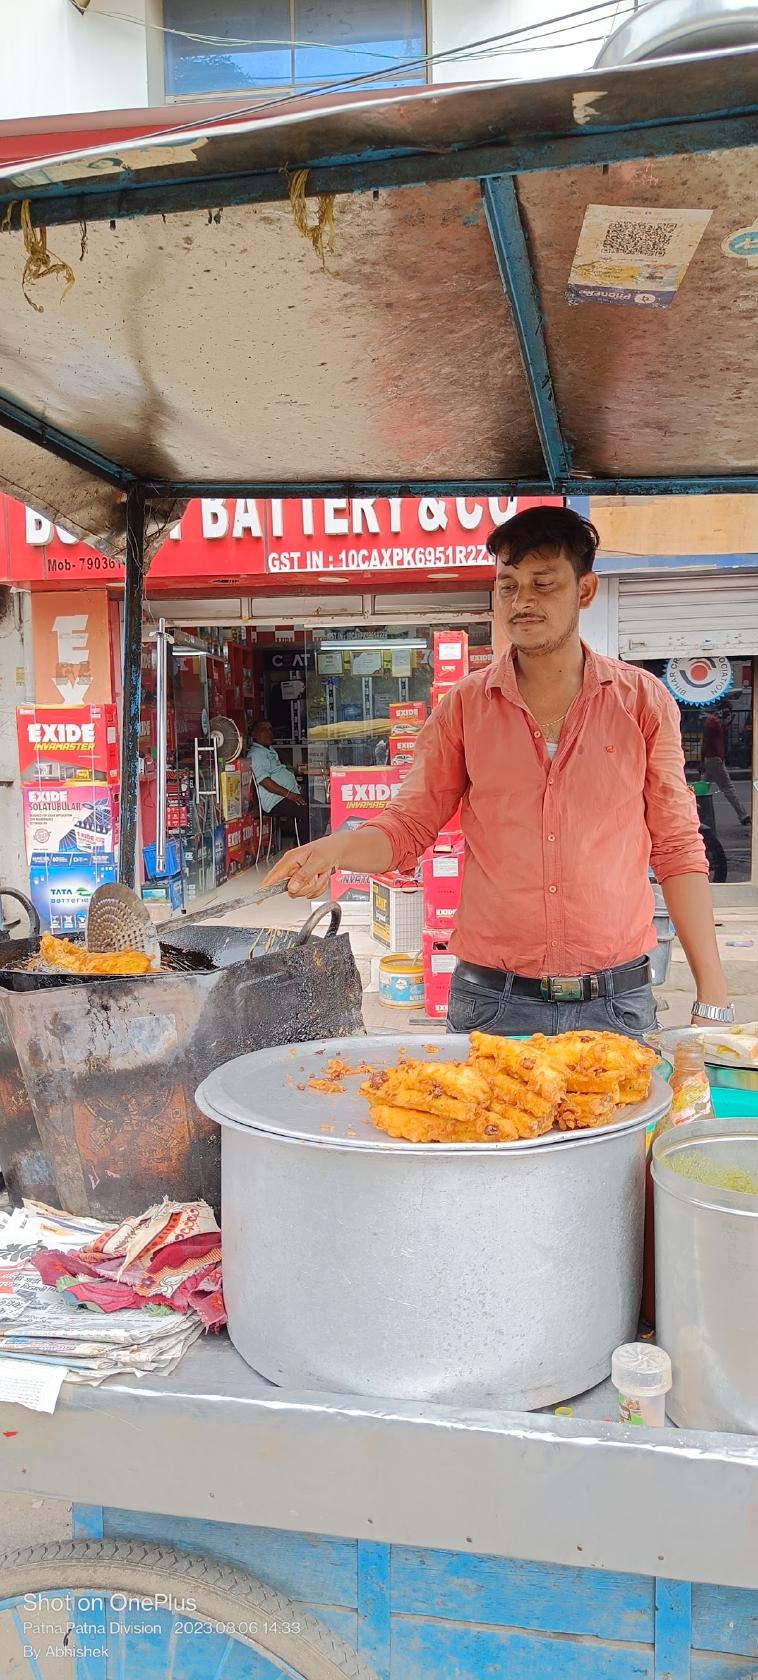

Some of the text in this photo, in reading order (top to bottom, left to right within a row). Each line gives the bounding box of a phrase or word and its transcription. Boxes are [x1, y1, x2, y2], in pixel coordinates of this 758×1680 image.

[202, 498, 403, 538] BATTERY
[418, 498, 448, 531] &
[48, 559, 76, 571] Mob-
[268, 551, 301, 572] GST
[306, 551, 323, 571] IN
[711, 657, 728, 695] OCIATION
[27, 723, 95, 743] EXIDE
[33, 743, 95, 751] INVAMASTER
[28, 790, 67, 802] EXIDE
[29, 802, 81, 811] SOLATUBULAR
